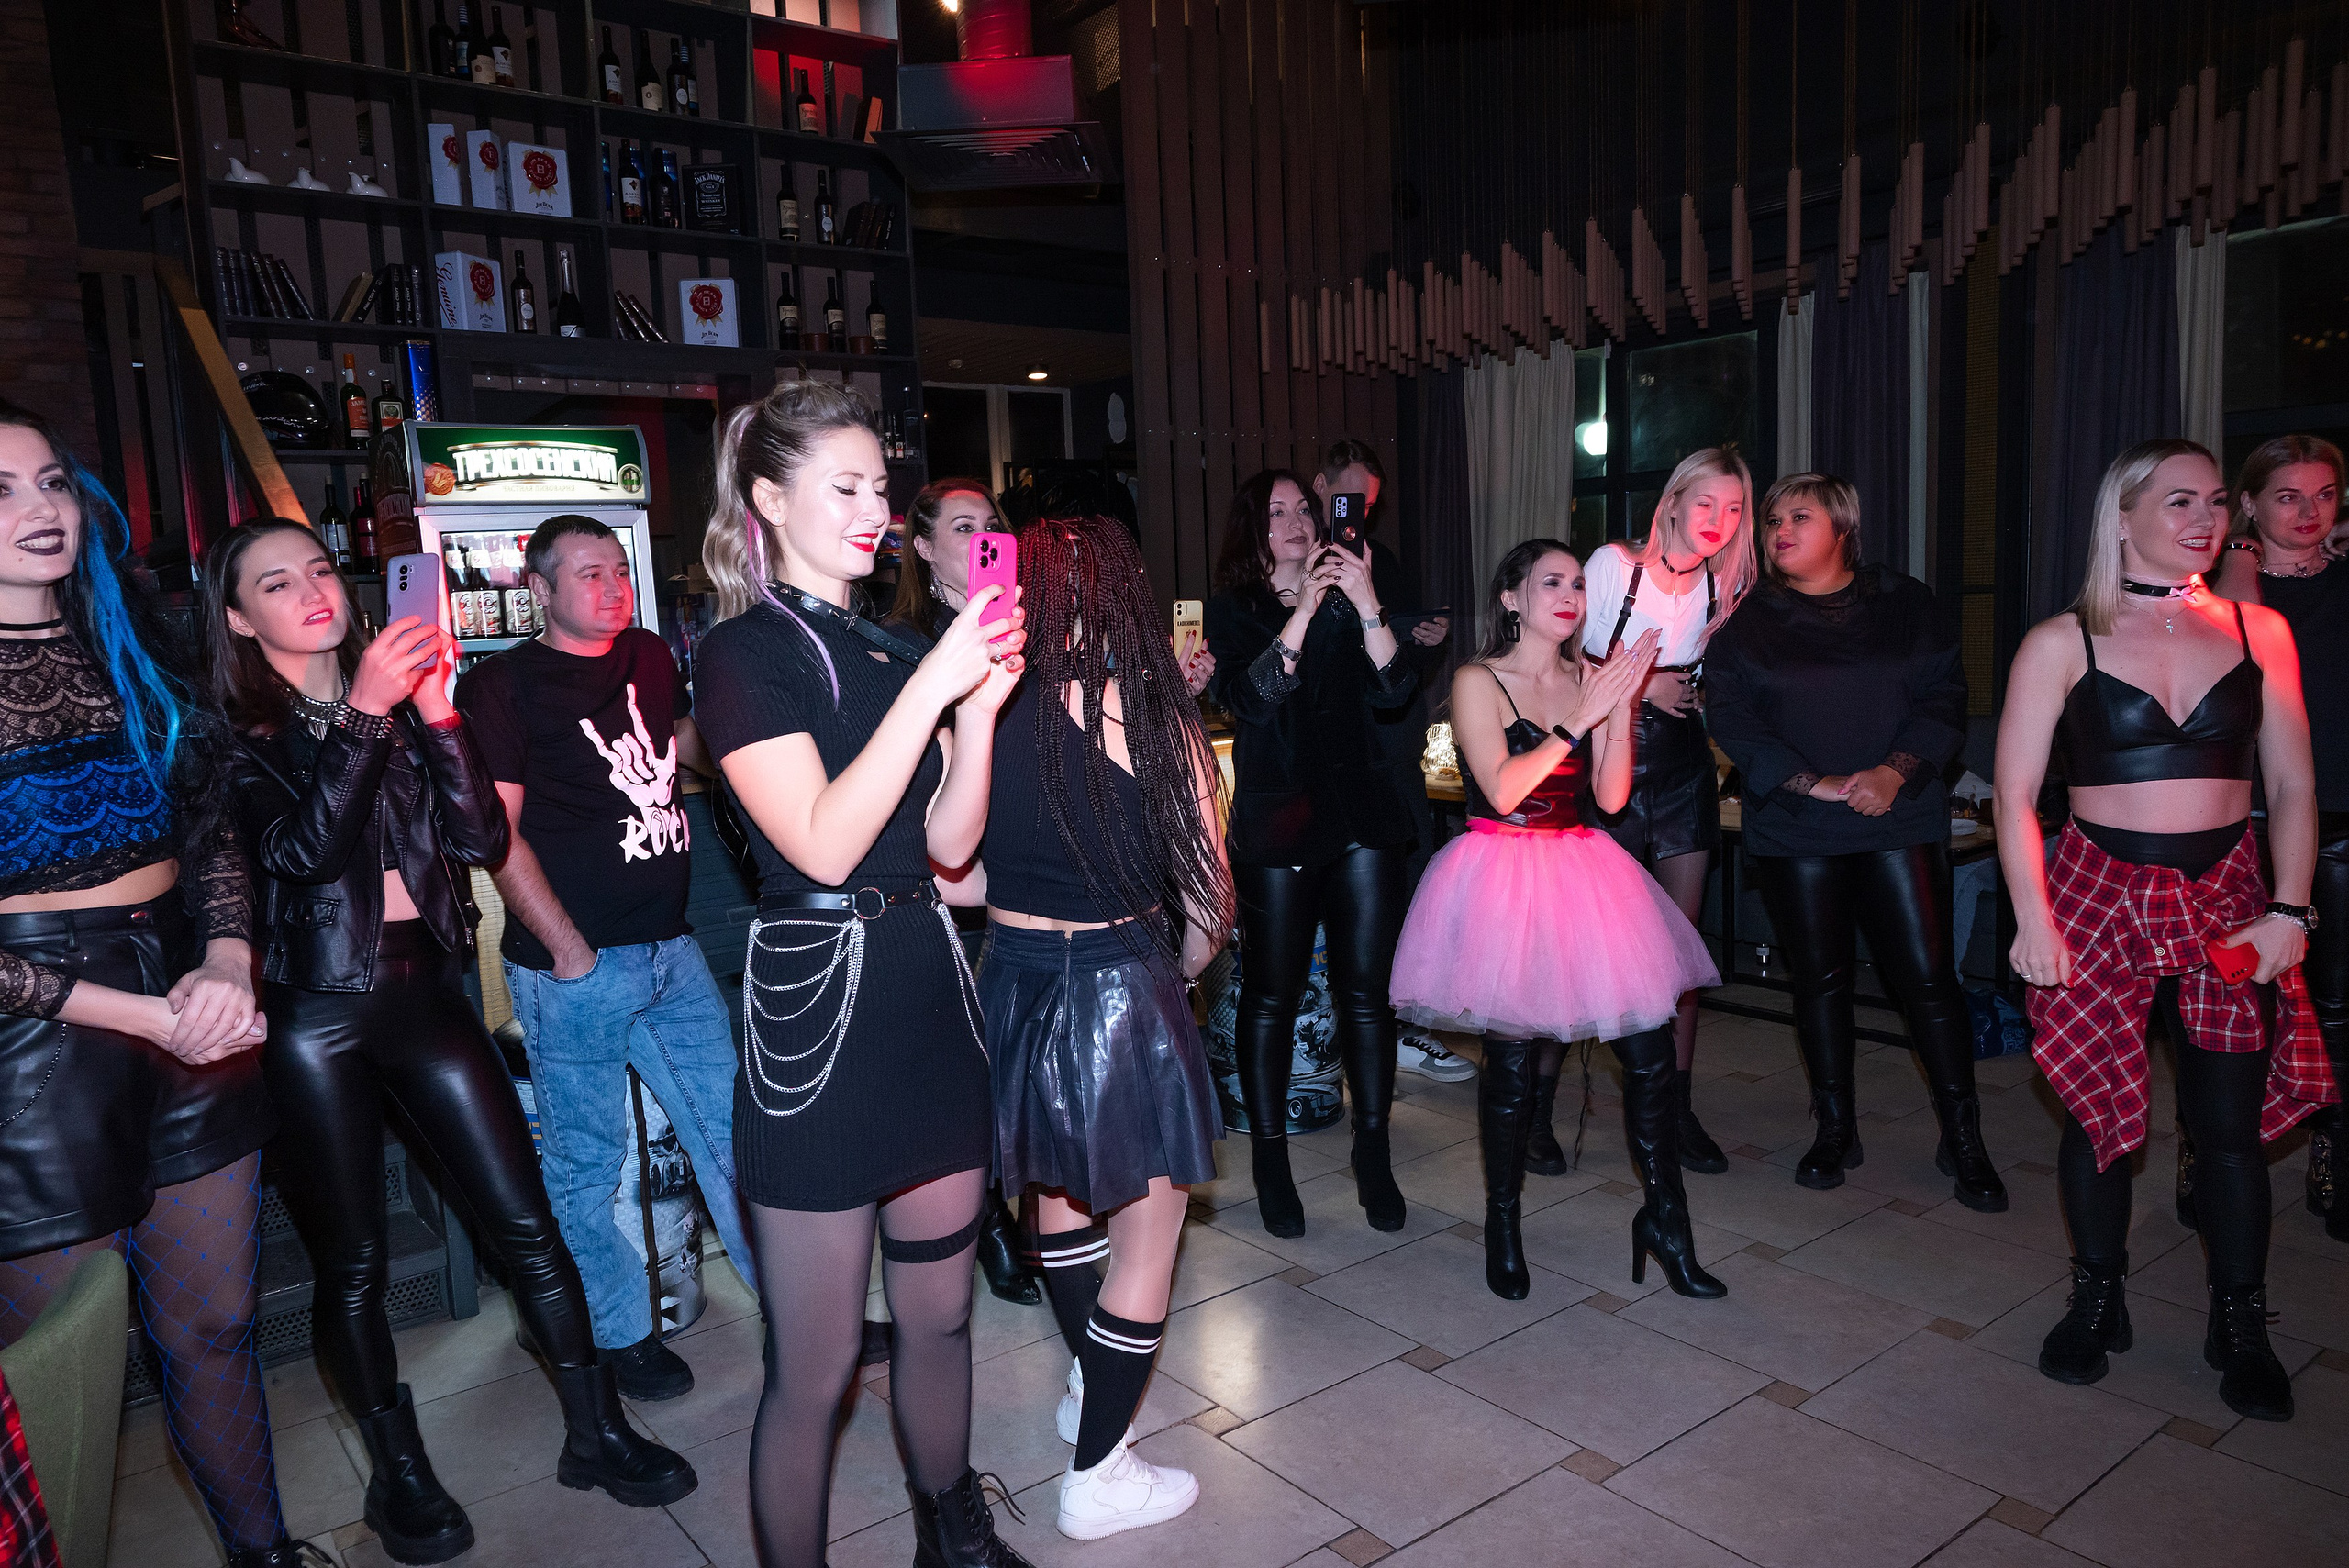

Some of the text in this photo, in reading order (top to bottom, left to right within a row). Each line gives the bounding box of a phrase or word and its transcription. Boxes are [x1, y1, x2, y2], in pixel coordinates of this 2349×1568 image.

[694, 175, 706, 185] JACK
[435, 262, 458, 328] Genuine
[502, 484, 533, 493] ЧАСТНАЯ
